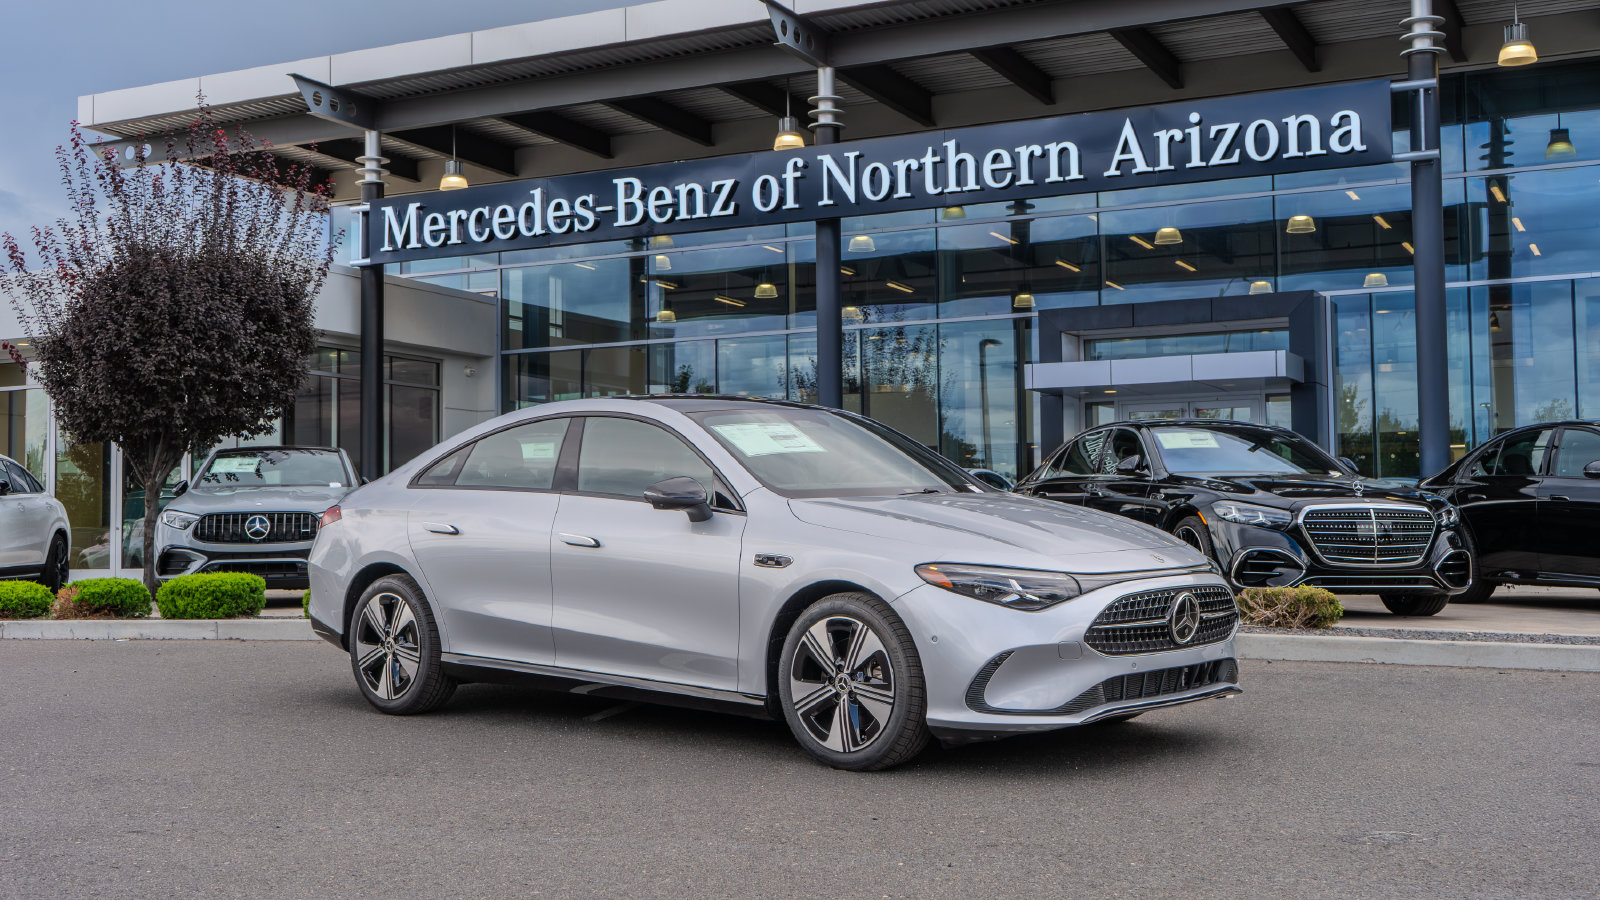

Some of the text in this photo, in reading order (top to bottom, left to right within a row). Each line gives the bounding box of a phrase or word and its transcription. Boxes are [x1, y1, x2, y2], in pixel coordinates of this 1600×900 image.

[380, 109, 1367, 252] Mercedes-Benz of Northern Arizona
